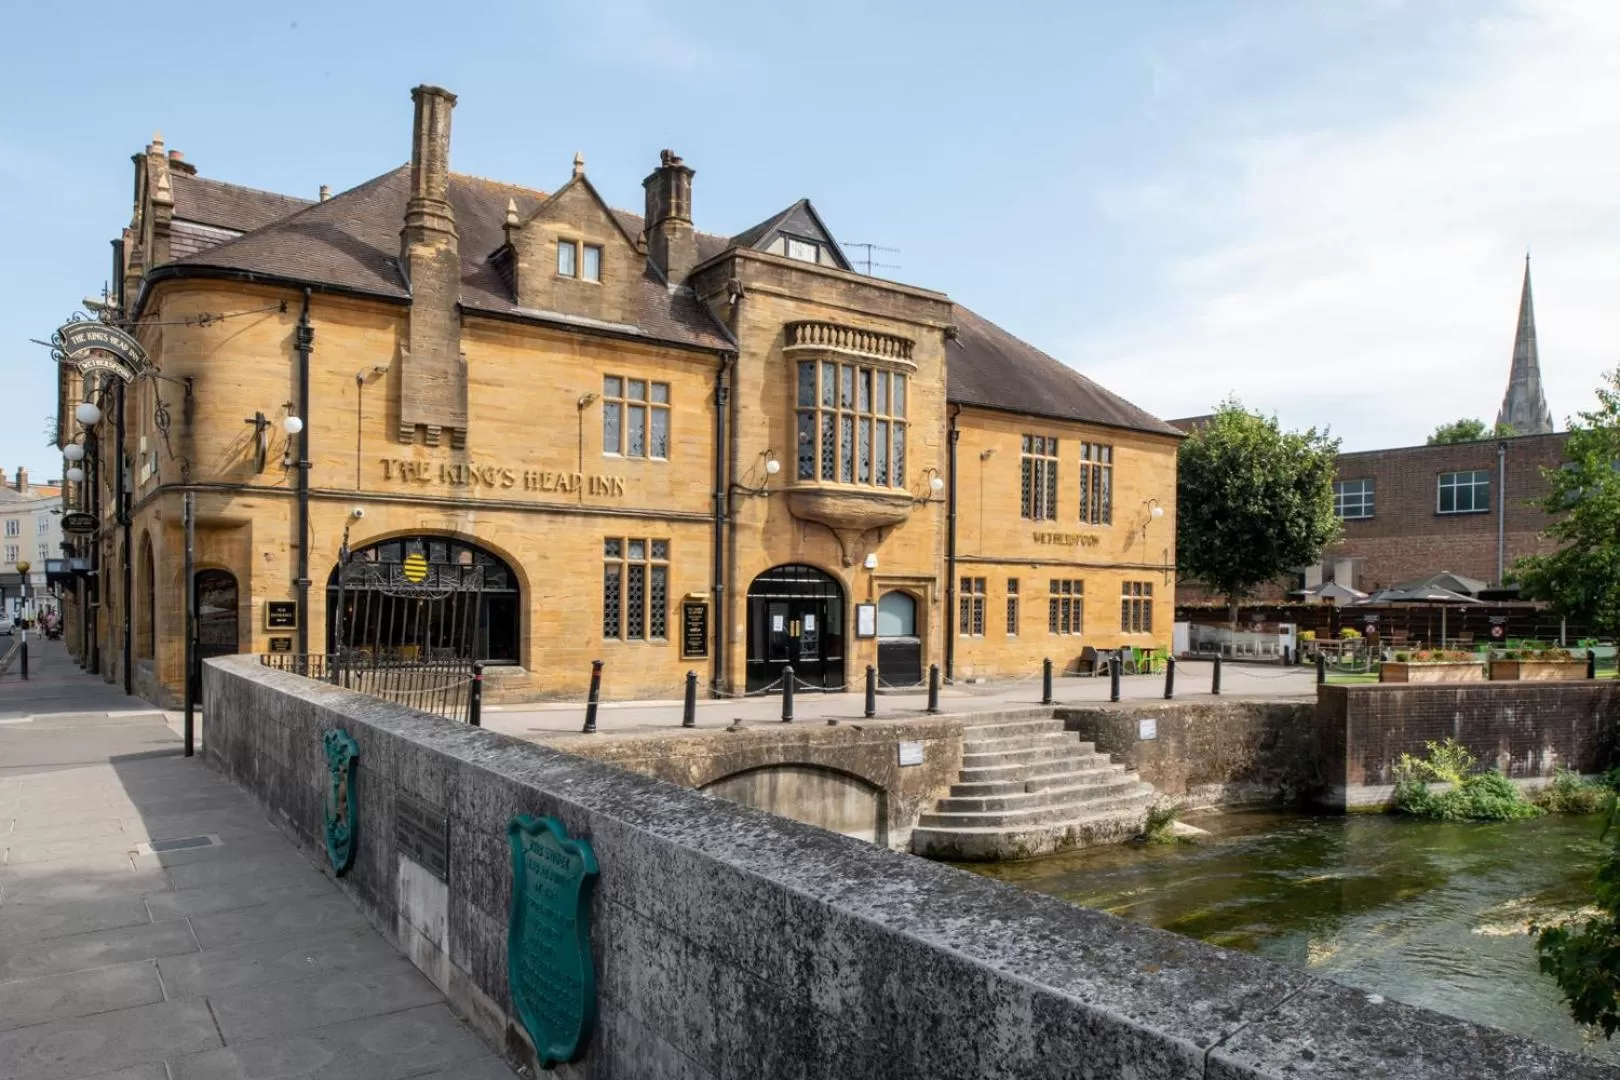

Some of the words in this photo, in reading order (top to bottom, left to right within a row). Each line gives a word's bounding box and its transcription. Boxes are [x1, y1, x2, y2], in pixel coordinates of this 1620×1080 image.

[70, 333, 86, 345] THE
[110, 336, 129, 351] HEAD
[128, 349, 139, 362] INN
[379, 458, 432, 484] THE
[439, 463, 516, 489] KING'S
[523, 470, 582, 494] HEAD
[588, 475, 626, 497] INN
